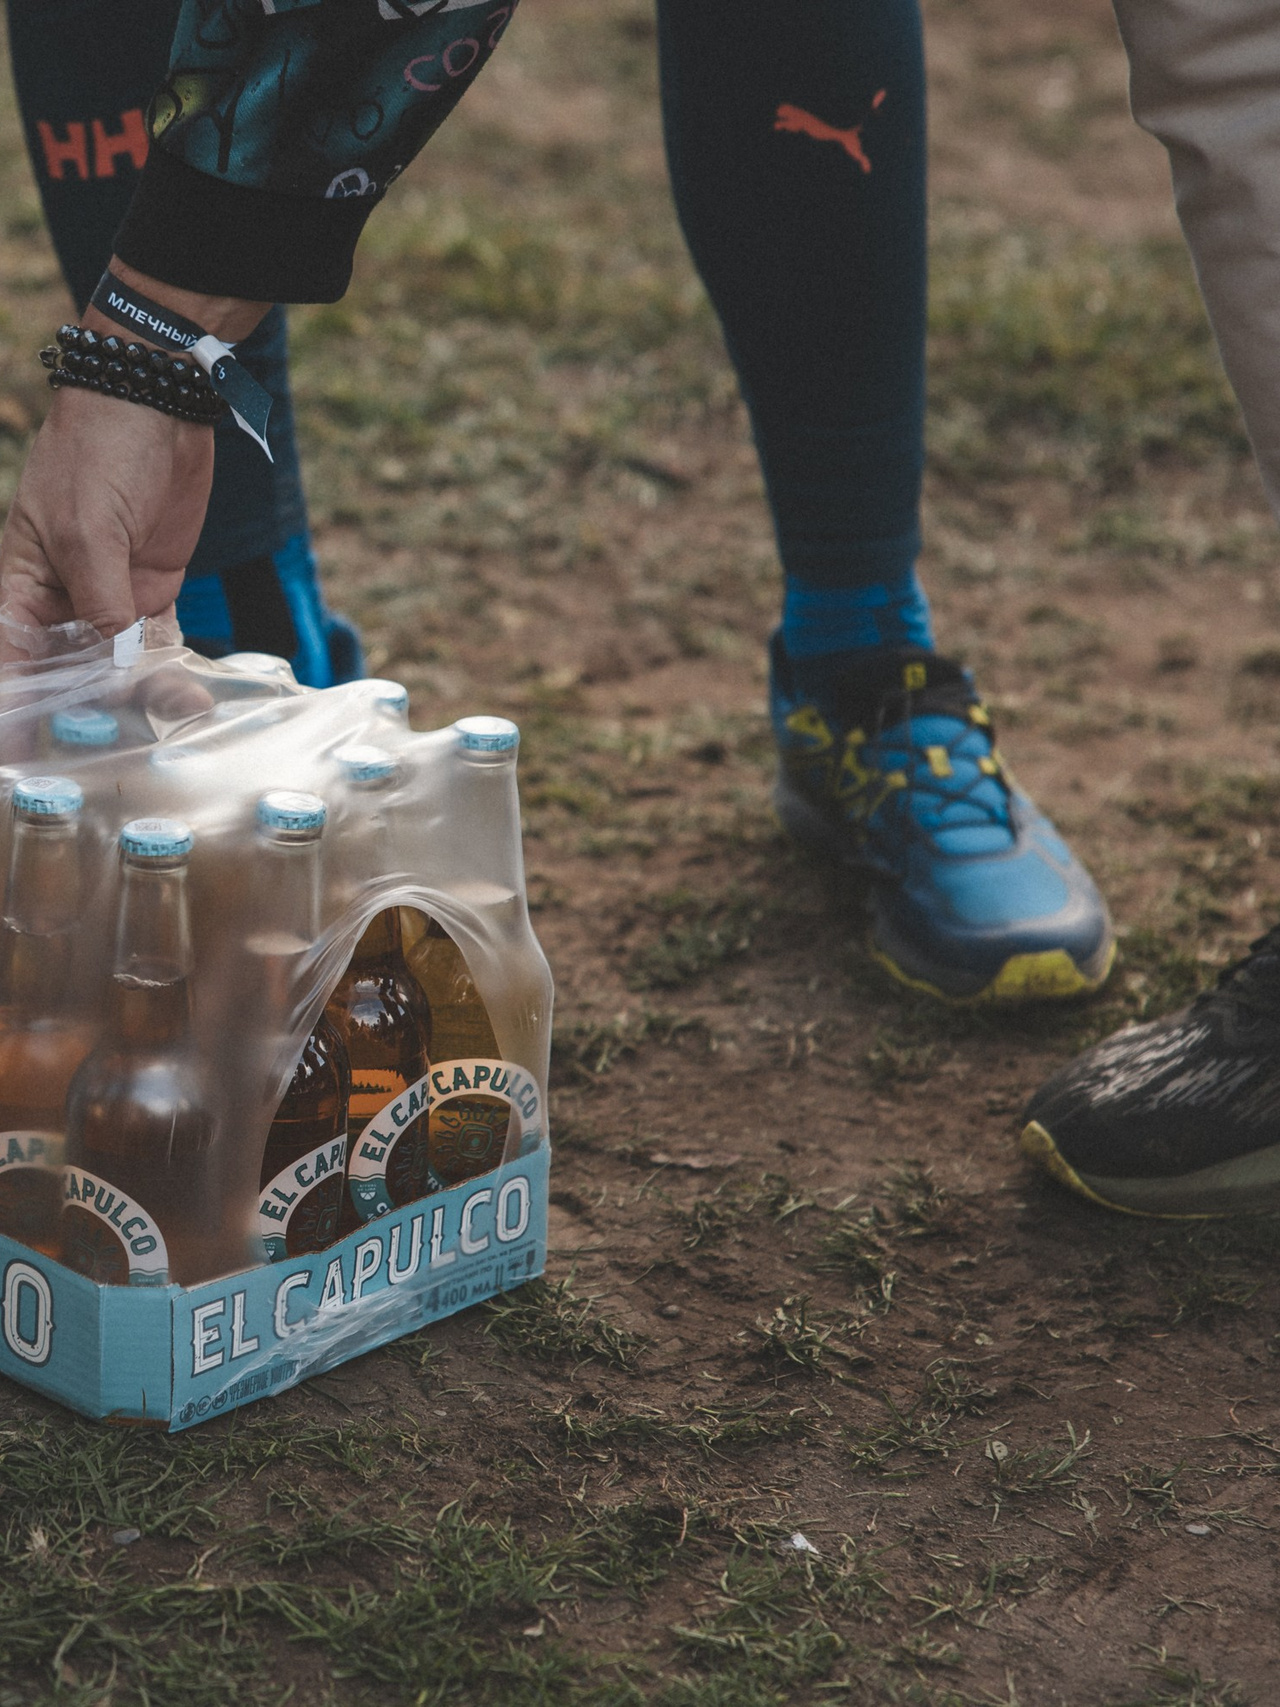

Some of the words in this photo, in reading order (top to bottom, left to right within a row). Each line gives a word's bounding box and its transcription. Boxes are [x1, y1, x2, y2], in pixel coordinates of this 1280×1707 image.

[36, 108, 150, 181] HH
[107, 291, 199, 348] МЛЕЧНЫЙ
[431, 1065, 539, 1121] CAPULCO
[359, 1128, 396, 1163] EL
[66, 1172, 157, 1257] APULCO
[259, 1187, 299, 1223] EL
[190, 1292, 260, 1379] EL
[272, 1174, 532, 1342] CAPULCO
[442, 1285, 468, 1309] 400
